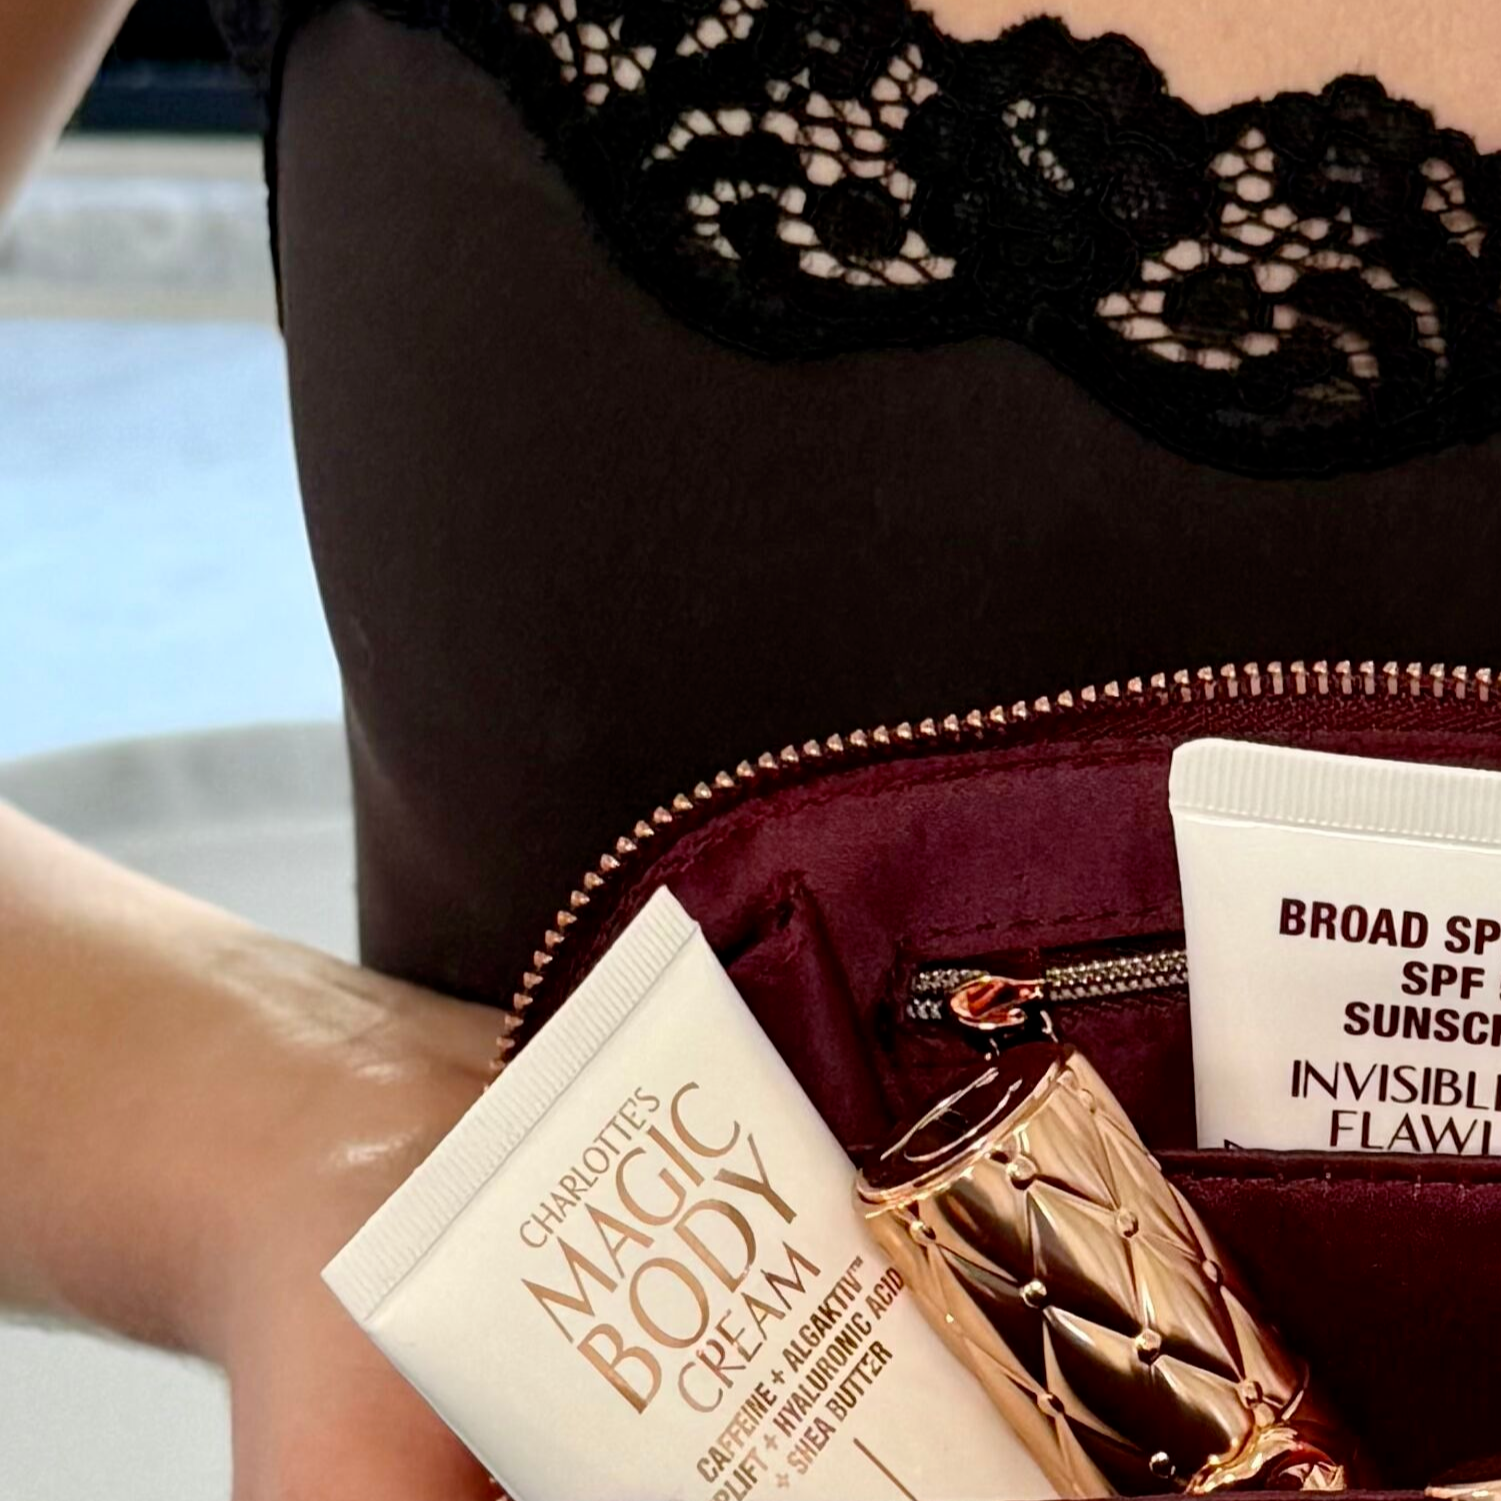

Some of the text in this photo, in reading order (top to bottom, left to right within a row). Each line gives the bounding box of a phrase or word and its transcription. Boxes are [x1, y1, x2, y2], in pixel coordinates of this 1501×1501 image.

[1278, 897, 1429, 950] BROAD
[1400, 960, 1486, 1000] SPF
[519, 1086, 662, 1249] CHARLOTTE'S
[520, 1081, 741, 1344] MAGIC
[576, 1132, 798, 1415] BODY
[677, 1240, 822, 1413] CREAM
[772, 1312, 873, 1438] HYALURONIC
[864, 1266, 905, 1320] ACID
[696, 1382, 778, 1484] CAFFEINE
[786, 1416, 837, 1475] SHEA
[825, 1340, 894, 1423] BUTTER
